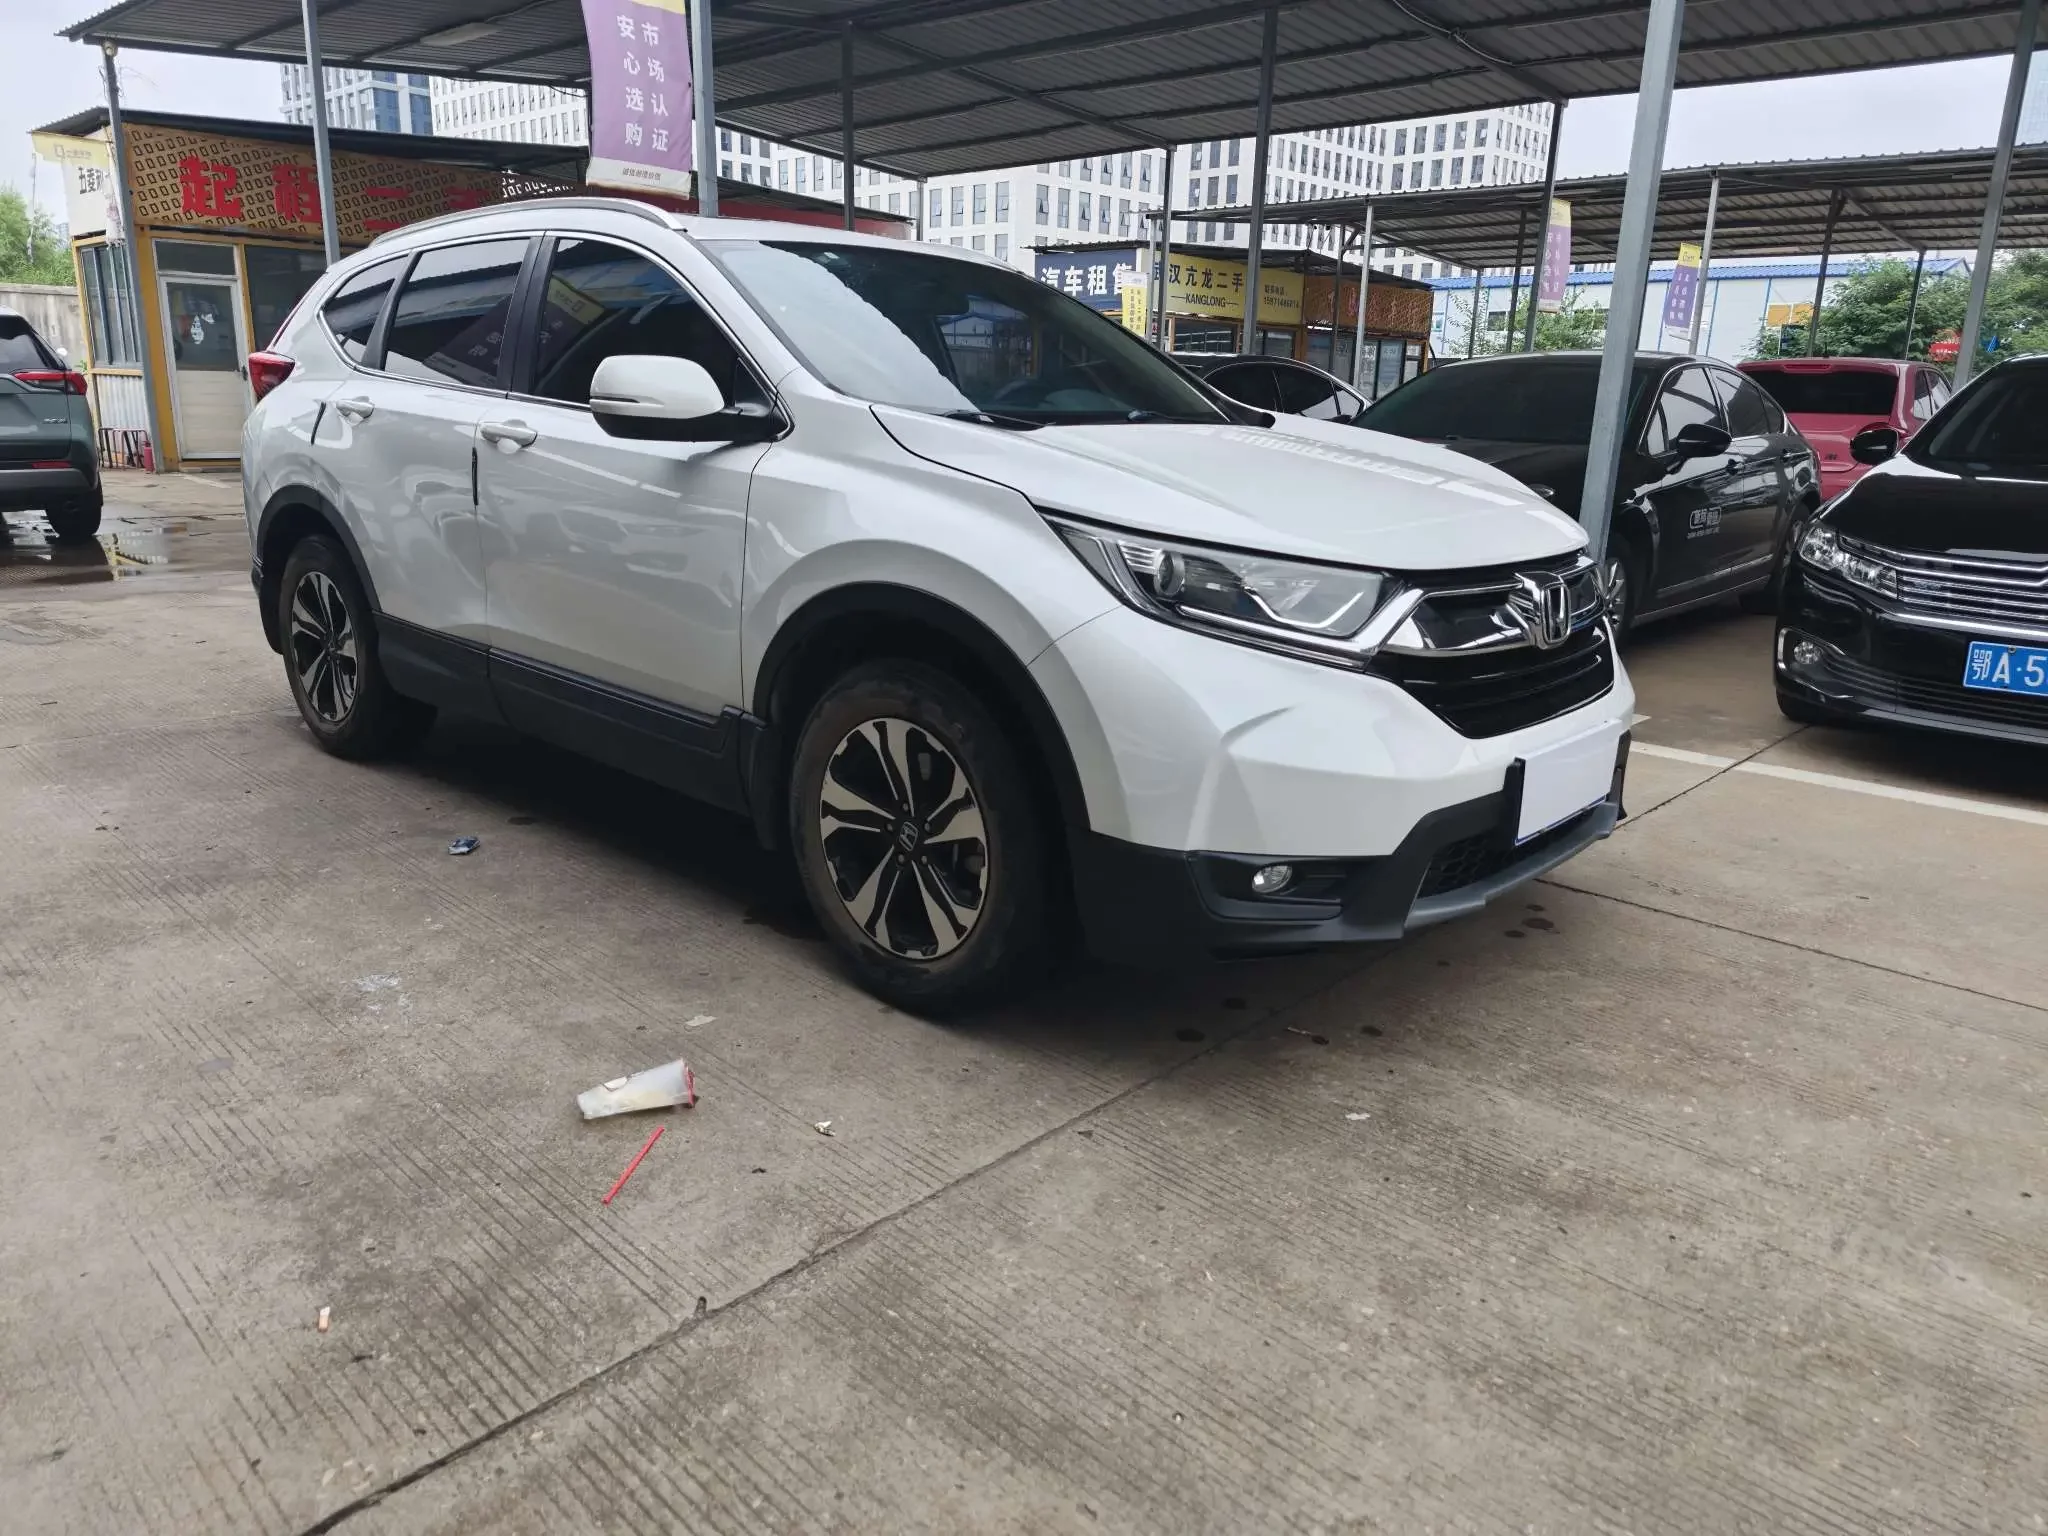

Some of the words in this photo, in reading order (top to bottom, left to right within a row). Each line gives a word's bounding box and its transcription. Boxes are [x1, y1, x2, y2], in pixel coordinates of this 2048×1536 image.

[616, 15, 644, 147] 安心选购
[641, 22, 669, 152] 市场认证
[1185, 292, 1227, 308] KANGLONG
[1971, 648, 2048, 688] 鄂A·5
